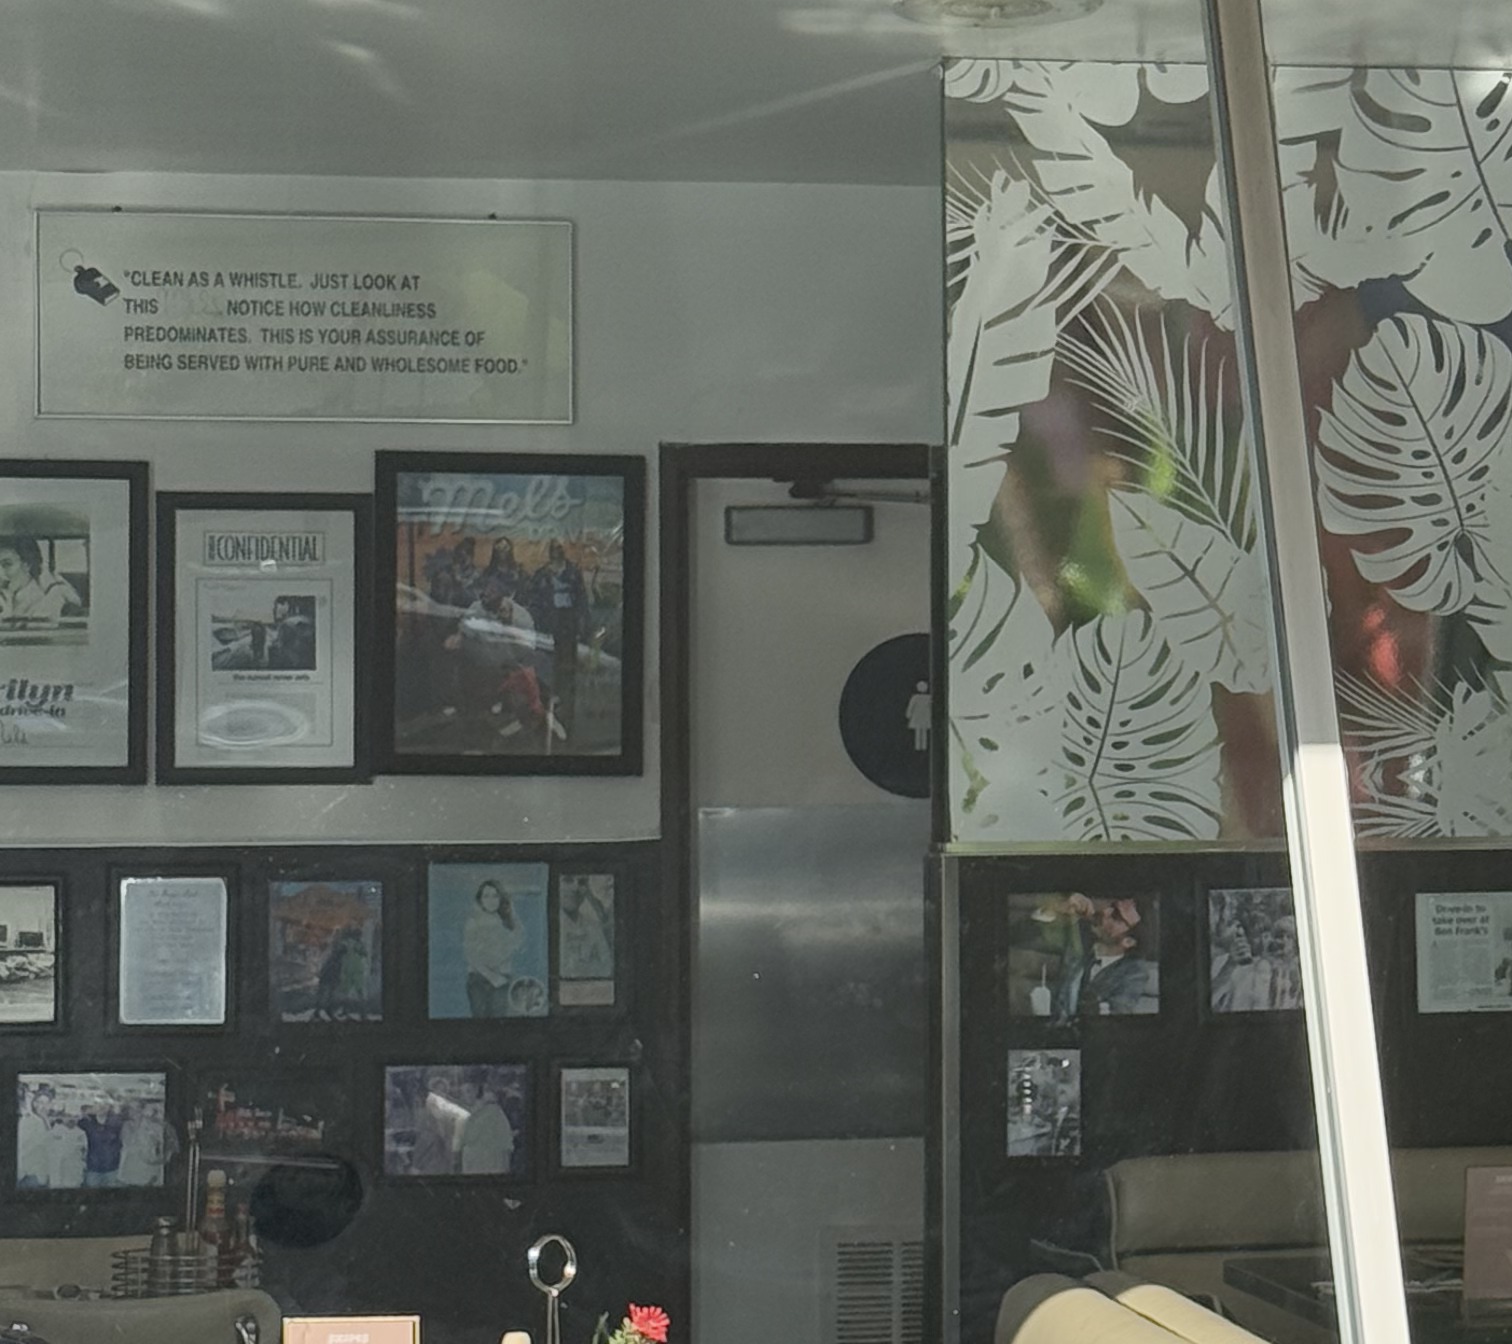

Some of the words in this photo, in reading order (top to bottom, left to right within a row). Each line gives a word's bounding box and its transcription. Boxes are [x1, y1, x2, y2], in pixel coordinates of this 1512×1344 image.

[188, 271, 209, 288] AS
[213, 272, 225, 288] A
[229, 272, 303, 289] WHISTLE.
[310, 273, 348, 290] JUST
[353, 273, 396, 291] LOOK
[400, 275, 420, 291] AT
[123, 297, 159, 315] THIS
[226, 299, 285, 317] NOTICE
[289, 300, 326, 317] HOW
[330, 301, 437, 319] CLEANLINESS
[124, 325, 252, 343] PREDOMINATES.
[260, 327, 295, 344] THIS
[300, 328, 314, 344] IS
[318, 328, 361, 345] YOUR
[365, 329, 460, 346] ASSURANCE
[465, 330, 485, 347] OF
[124, 353, 173, 371] BEING
[177, 354, 240, 371] SERVED
[244, 355, 283, 372] WITH
[288, 355, 329, 372] PURE
[334, 356, 367, 373] AND
[372, 357, 470, 374] WHOLESOME
[217, 535, 319, 561] CONFIDENTIAL
[0, 679, 74, 708] ilyn
